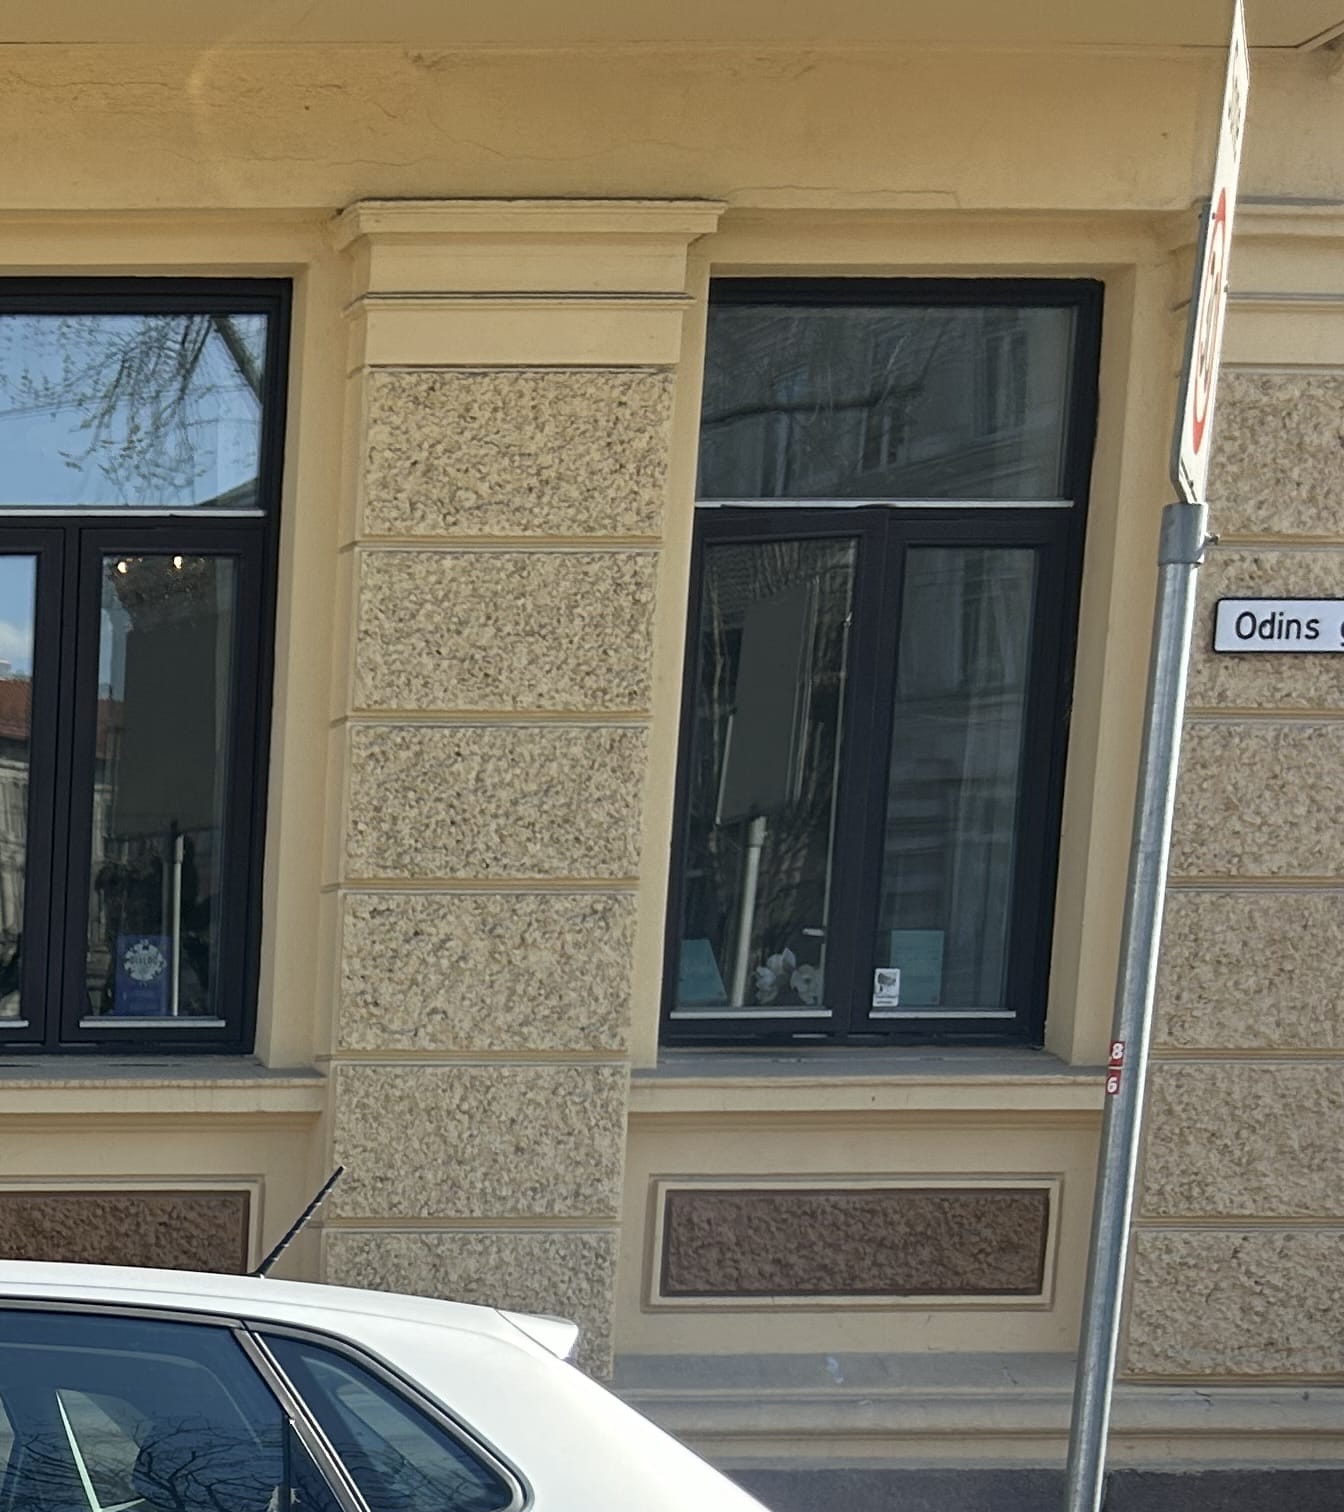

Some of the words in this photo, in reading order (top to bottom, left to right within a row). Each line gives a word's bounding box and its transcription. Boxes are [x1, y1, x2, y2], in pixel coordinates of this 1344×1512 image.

[1235, 610, 1320, 640] Odins
[1112, 1042, 1124, 1060] 8
[1107, 1076, 1118, 1094] 6
